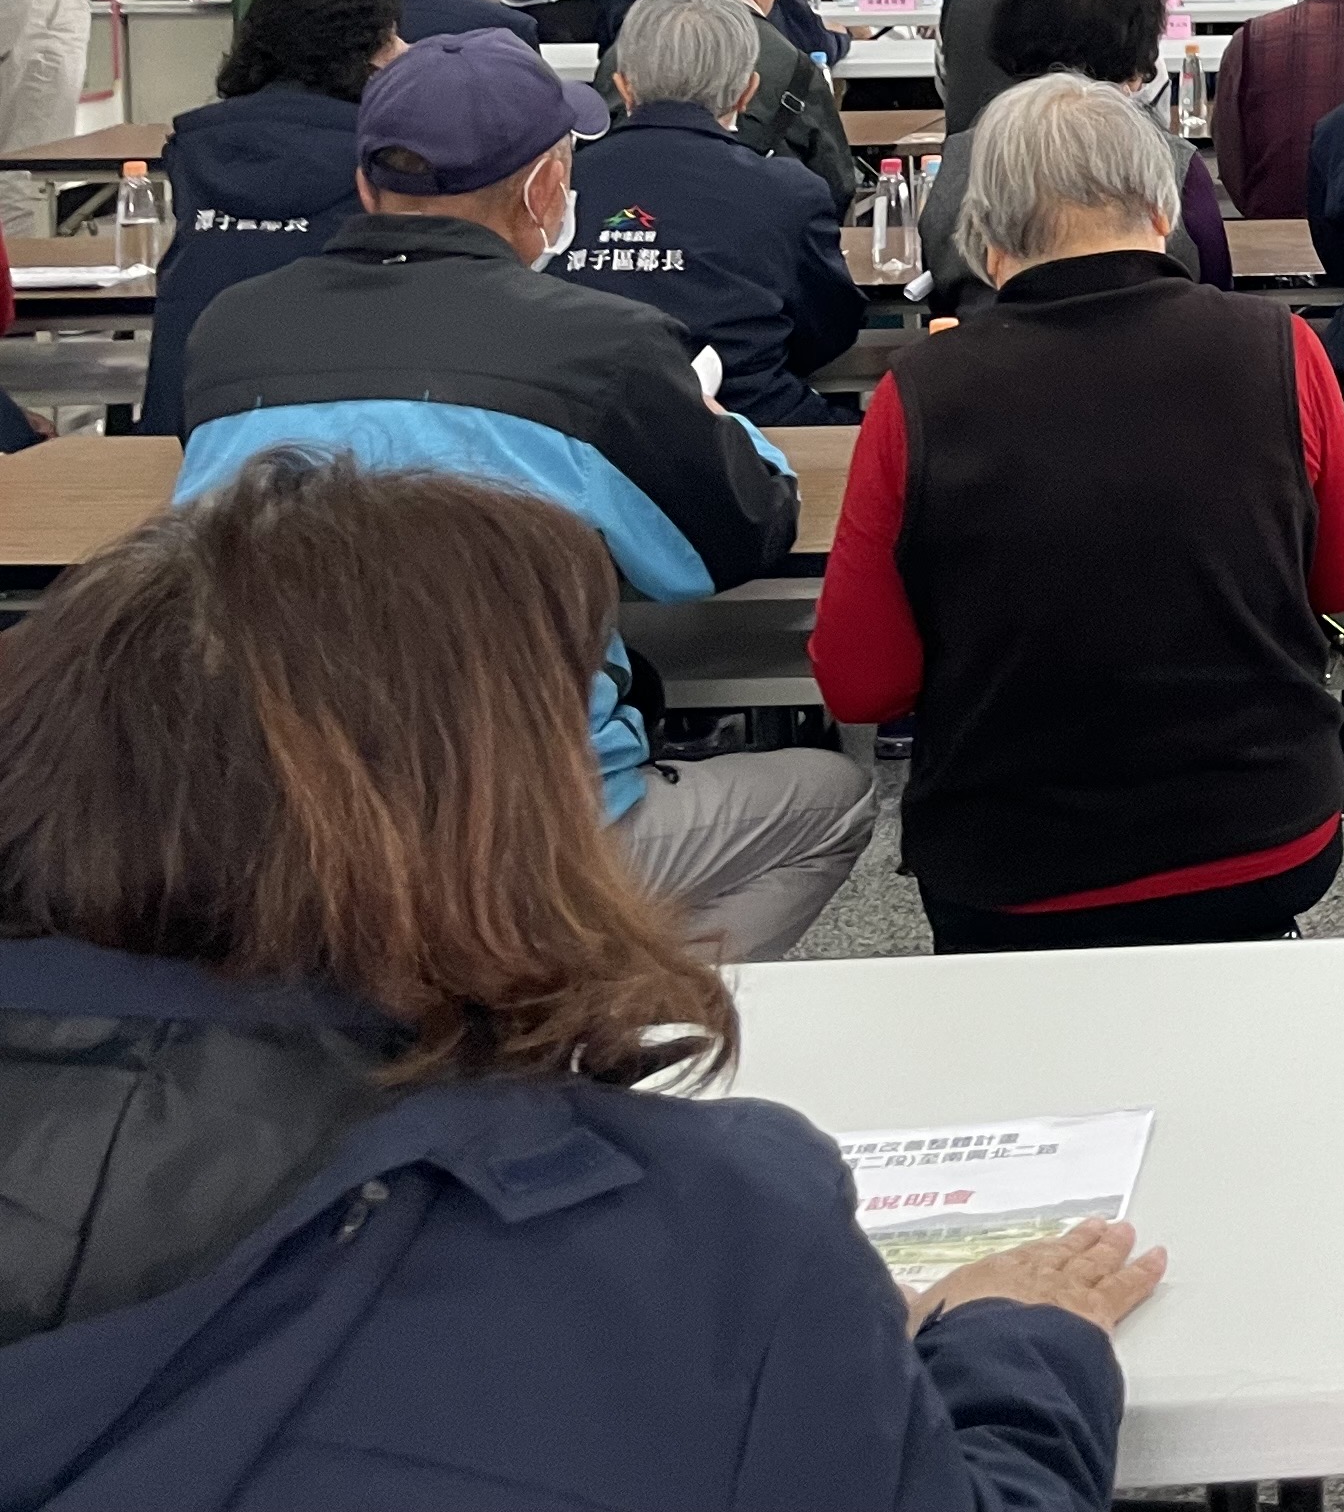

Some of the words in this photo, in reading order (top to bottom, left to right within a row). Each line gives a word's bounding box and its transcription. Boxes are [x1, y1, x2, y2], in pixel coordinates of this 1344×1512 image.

[566, 248, 686, 272] 潭子區鄰長
[864, 1189, 976, 1211] 說明會
